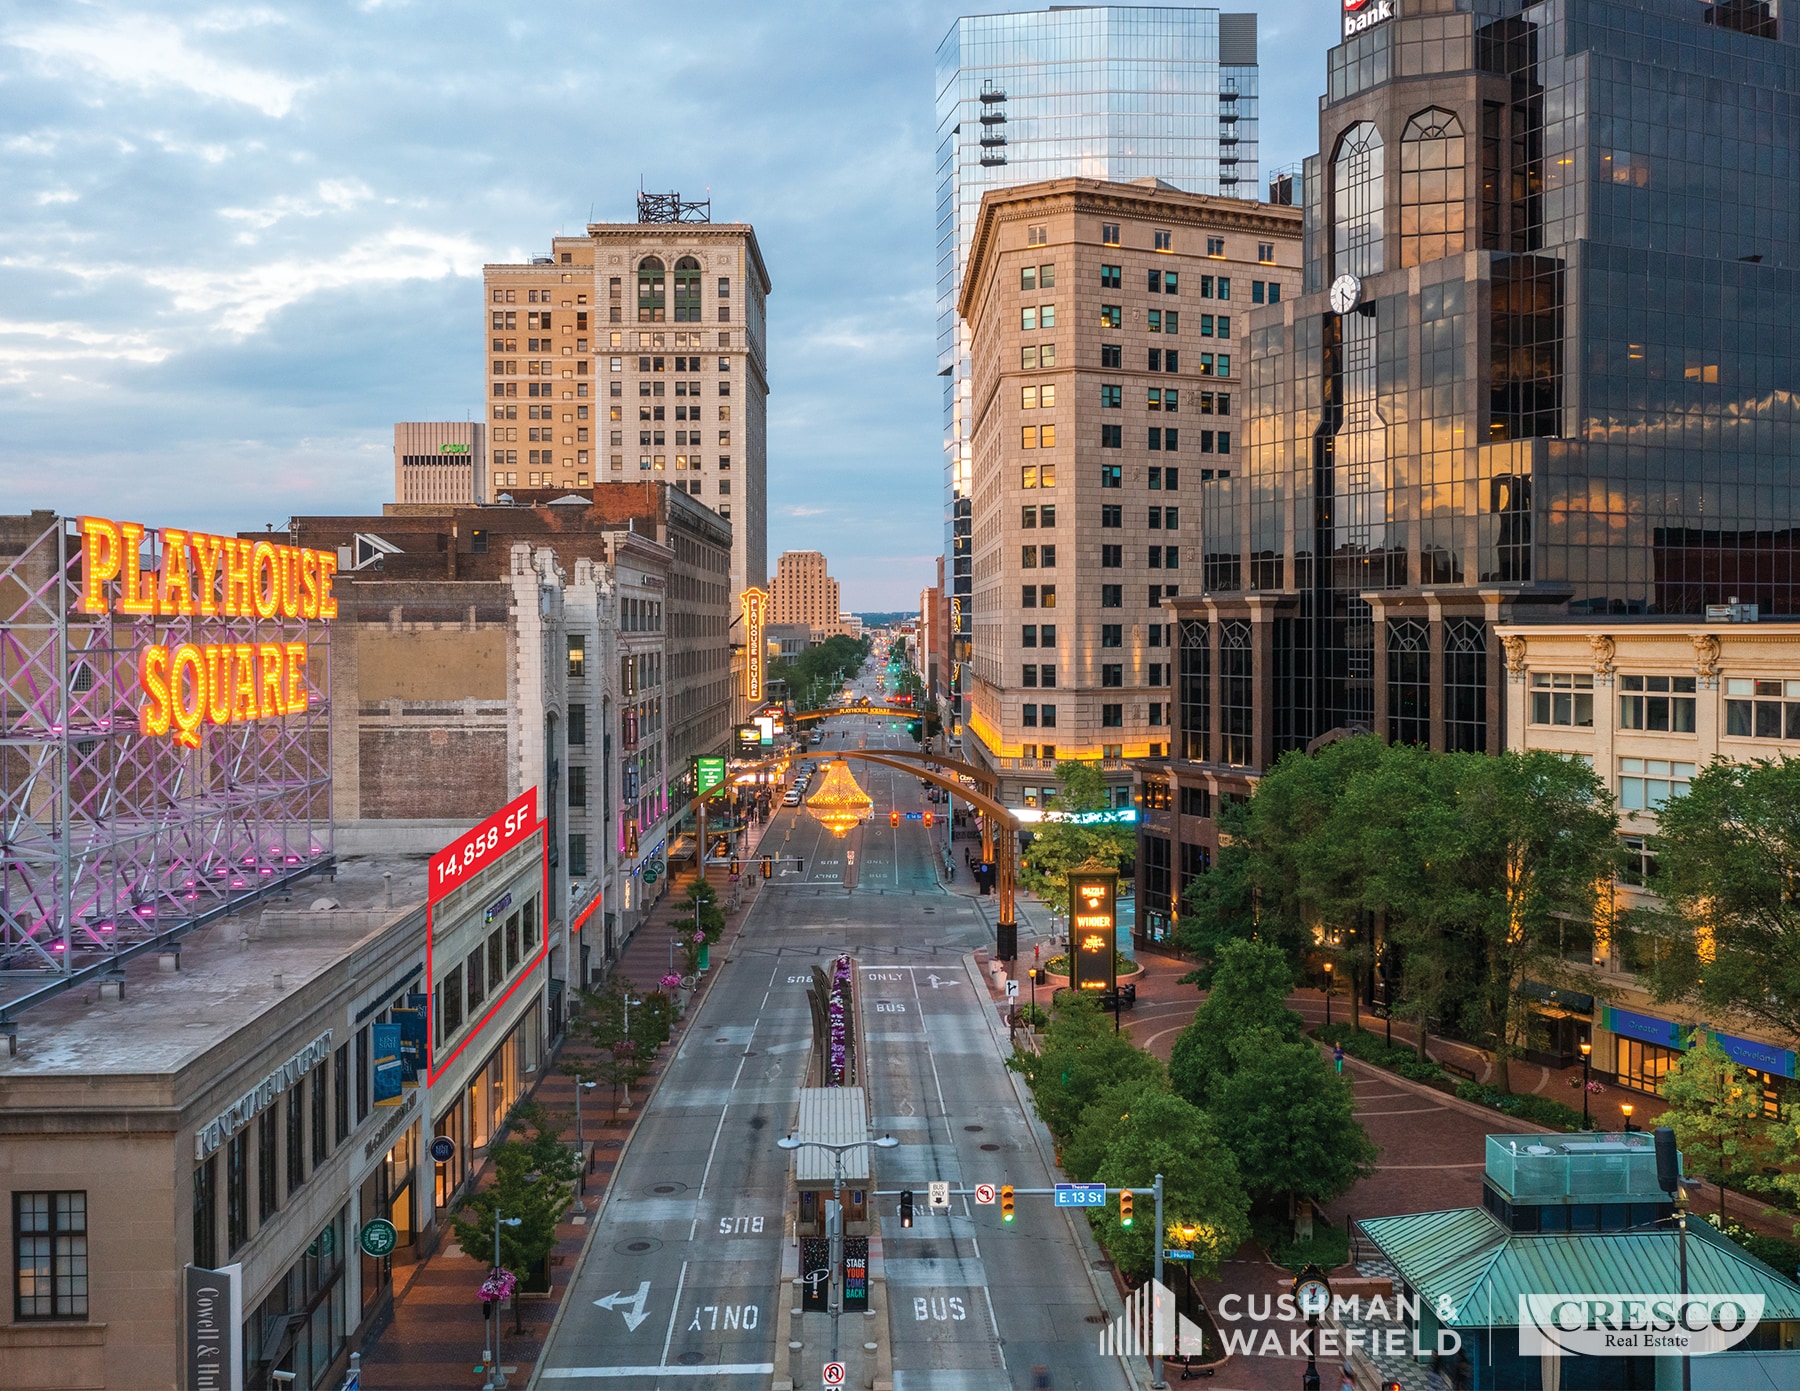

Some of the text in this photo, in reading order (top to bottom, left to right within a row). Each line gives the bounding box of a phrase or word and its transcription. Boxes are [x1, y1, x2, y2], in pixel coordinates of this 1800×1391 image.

[1345, 1, 1394, 36] bank
[440, 443, 470, 453] CSU
[76, 515, 338, 619] PLAYHOUSE
[750, 598, 758, 697] PLAYHOUSE SQUARE
[139, 642, 308, 749] SQUARE
[1082, 887, 1105, 896] DAZZLE
[1077, 916, 1110, 927] WINNER
[868, 973, 904, 982] ONLY
[876, 1004, 906, 1012] BUS
[1628, 1020, 1659, 1035] Greater
[1732, 1045, 1776, 1065] Cleveland
[195, 1105, 236, 1160] KENT
[233, 1078, 273, 1128] STATE
[1059, 1192, 1102, 1203] E. 13 St
[719, 1216, 764, 1234] BUS
[1173, 1250, 1192, 1259] Huron
[846, 1258, 865, 1268] STAGE
[846, 1268, 865, 1278] YOUR
[846, 1278, 865, 1288] COME
[845, 1288, 866, 1299] BACK!
[196, 1287, 220, 1340] Cowell
[913, 1297, 966, 1321] BUS
[688, 1305, 759, 1332] ONLY
[196, 1344, 220, 1358] &
